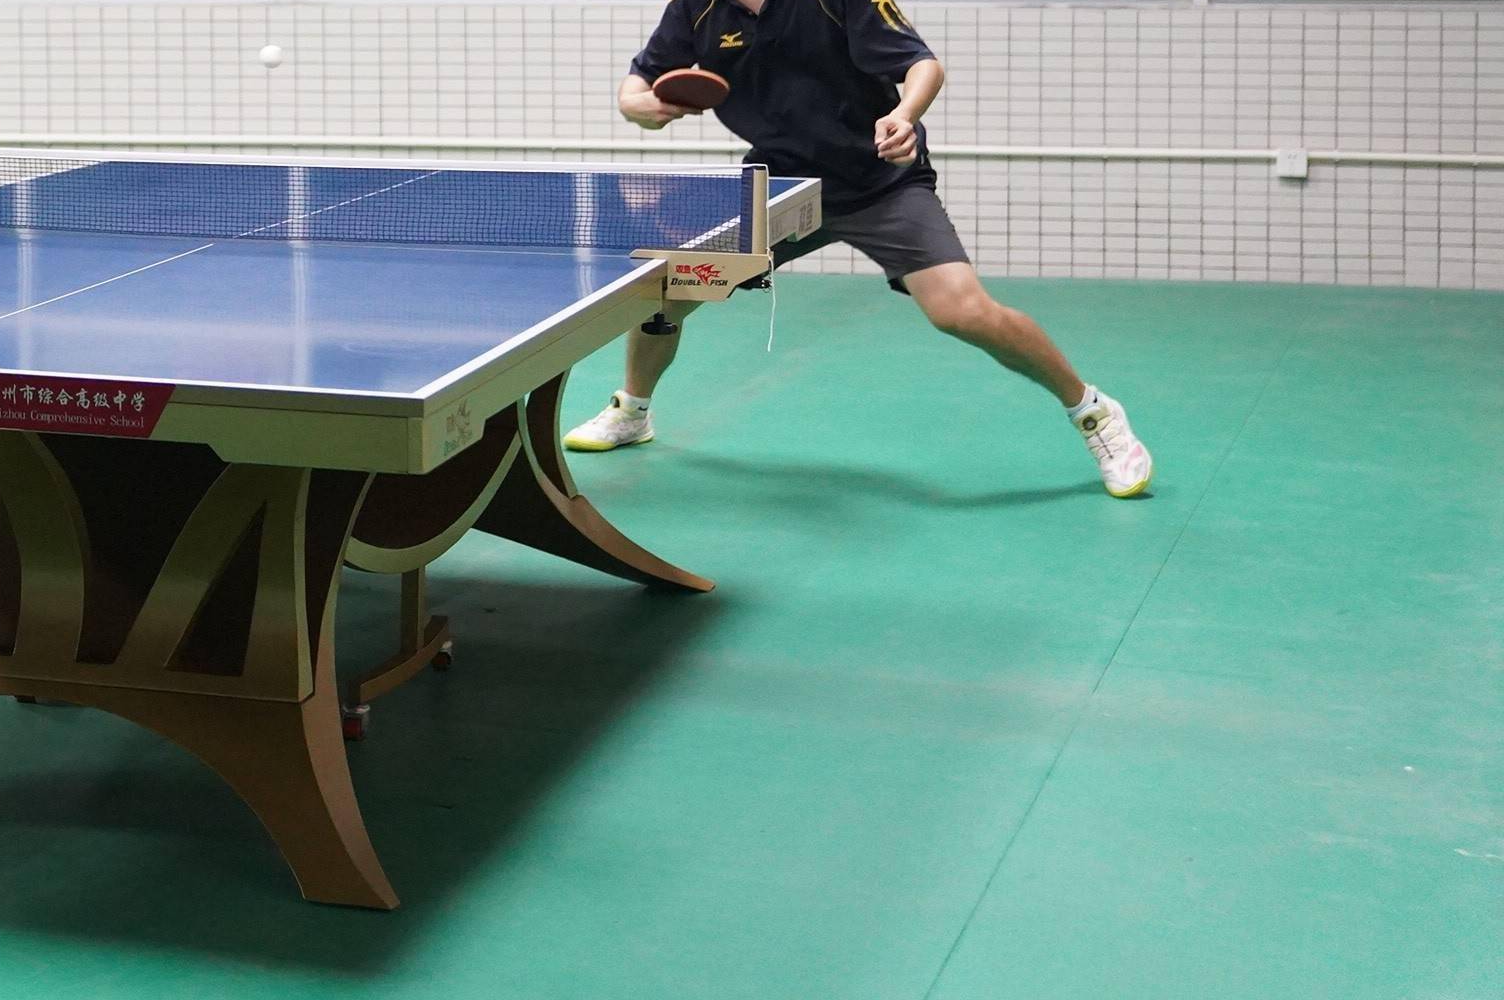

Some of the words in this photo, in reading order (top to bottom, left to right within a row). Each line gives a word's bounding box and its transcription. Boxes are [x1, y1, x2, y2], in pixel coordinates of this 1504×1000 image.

[671, 277, 702, 286] DOUBLE
[709, 279, 729, 287] FISH
[30, 409, 107, 426] Comprehensive
[110, 415, 145, 428] School
